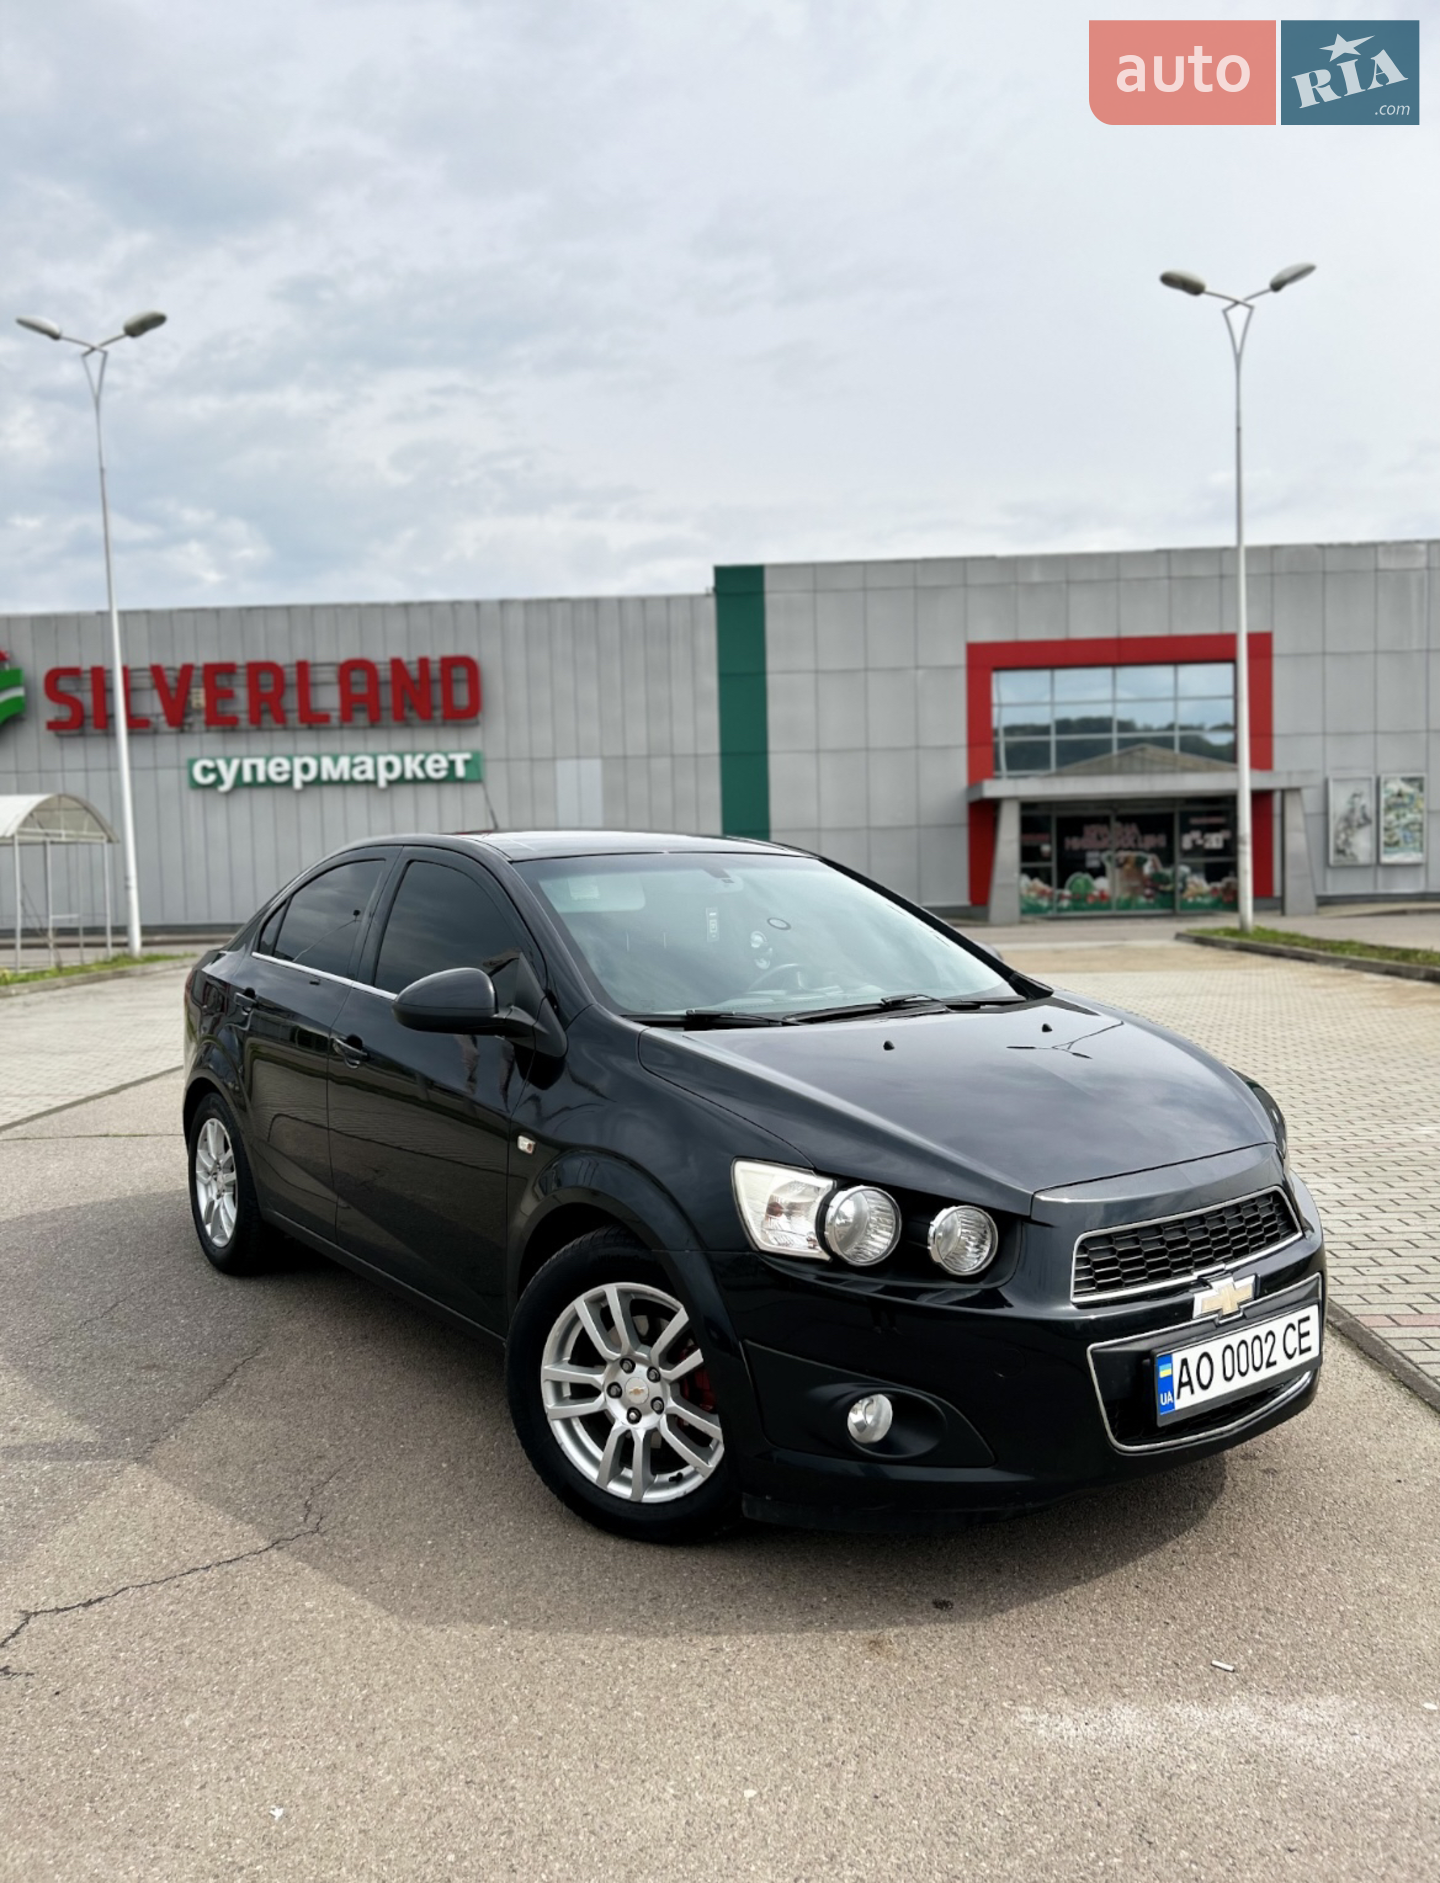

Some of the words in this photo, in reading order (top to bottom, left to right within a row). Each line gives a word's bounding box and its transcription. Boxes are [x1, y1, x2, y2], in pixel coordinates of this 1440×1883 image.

[43, 655, 483, 731] SILVERLAND
[191, 752, 472, 793] супермаркет
[1176, 1351, 1215, 1400] AO
[1221, 1330, 1278, 1382] 0002
[1282, 1315, 1313, 1361] CE
[1160, 1390, 1174, 1406] UA
